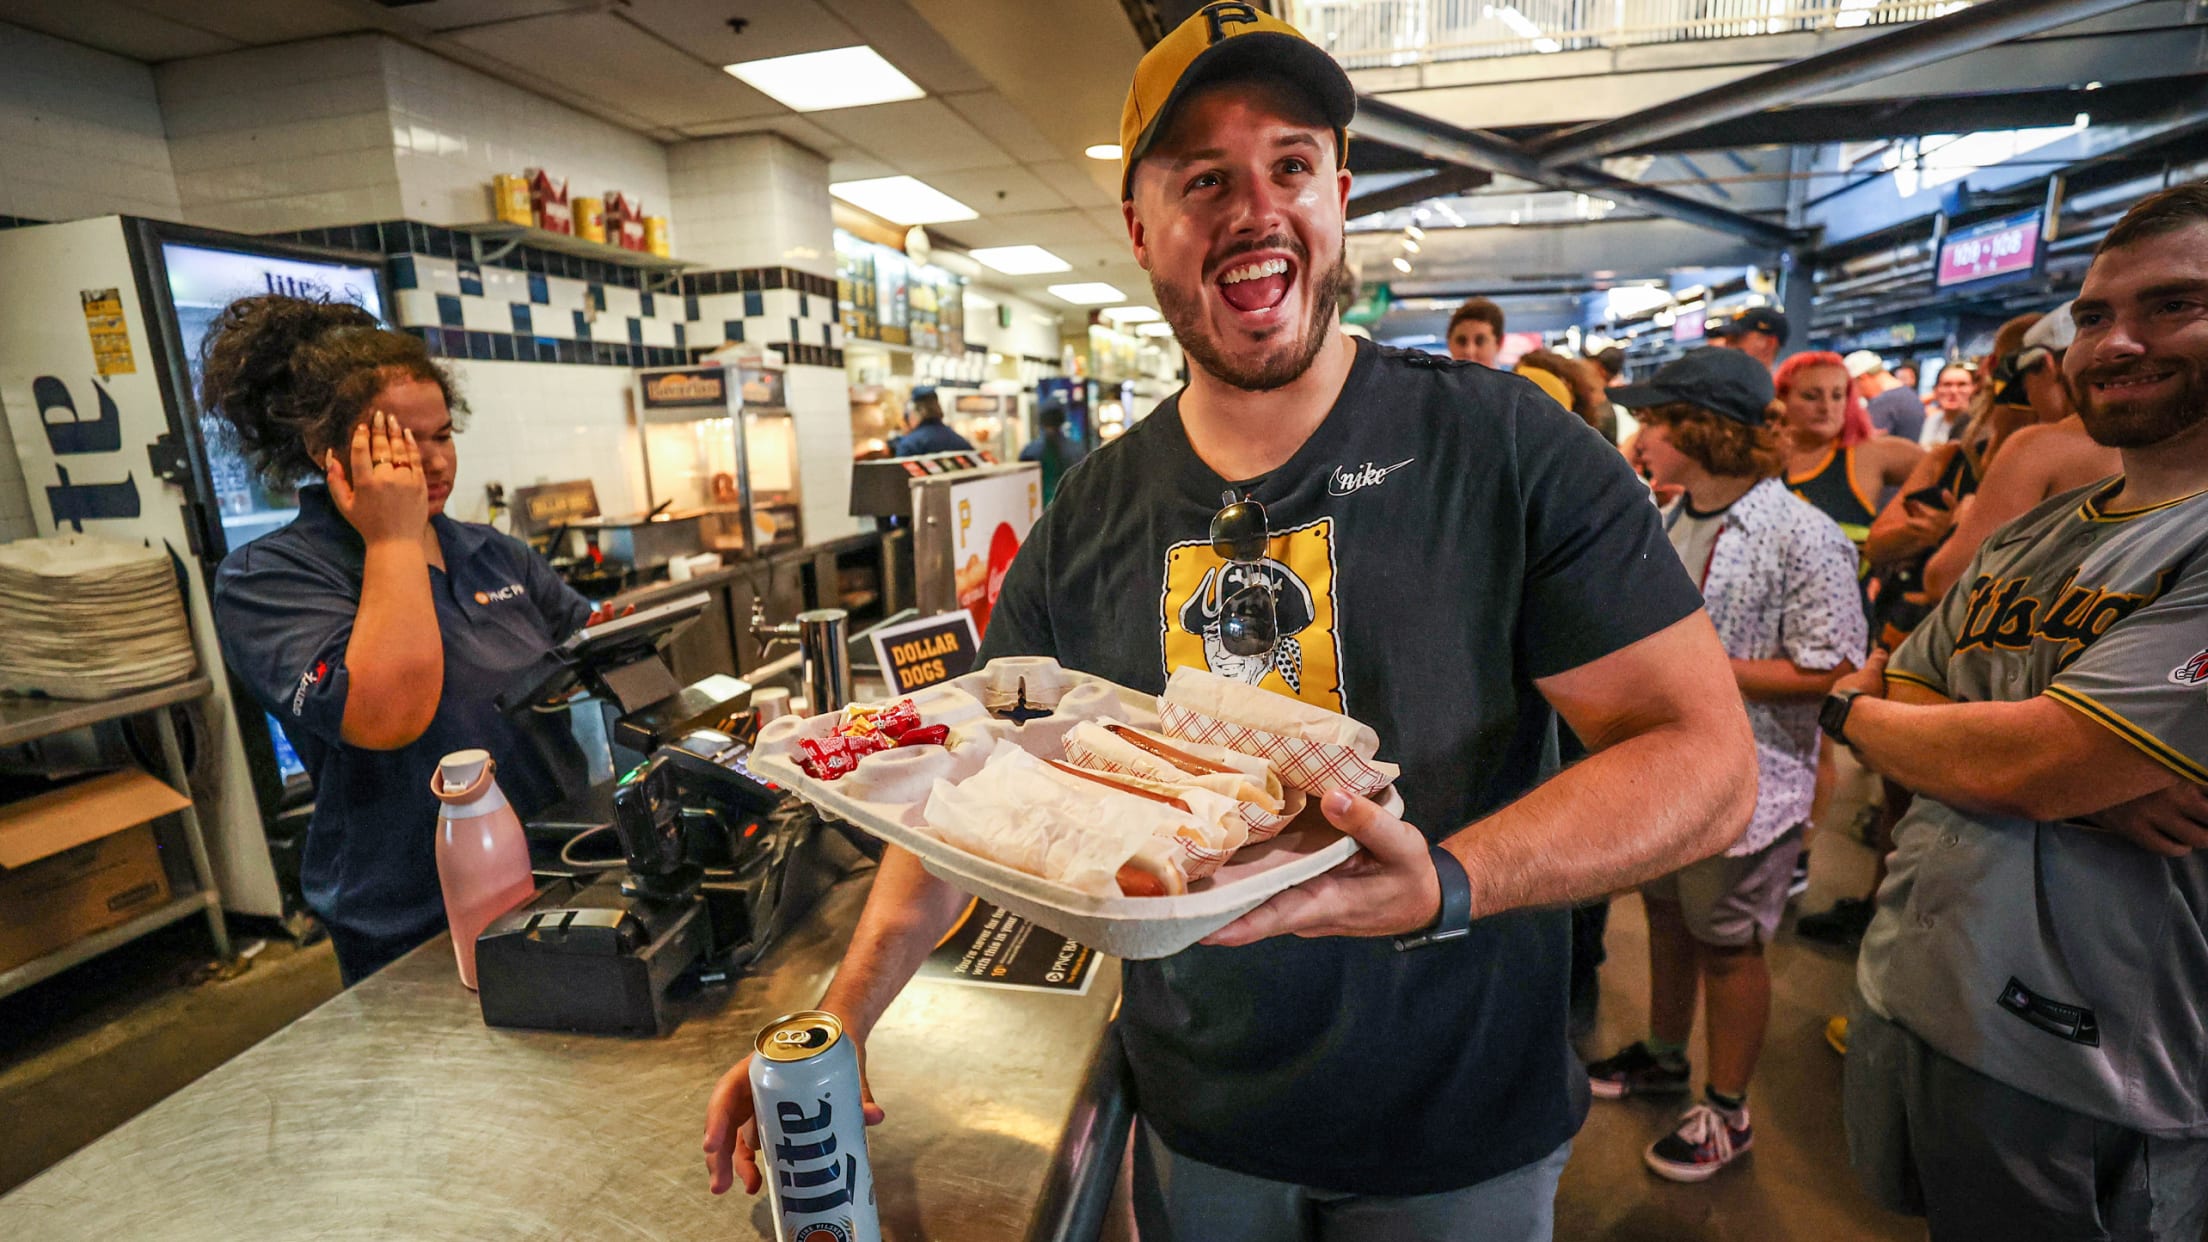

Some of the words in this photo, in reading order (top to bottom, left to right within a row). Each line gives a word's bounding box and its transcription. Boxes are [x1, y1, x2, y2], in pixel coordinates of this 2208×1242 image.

[891, 631, 960, 667] DOLLAR
[898, 658, 948, 689] DOGS
[972, 956, 991, 977] with
[984, 941, 1001, 962] this
[1051, 949, 1072, 973] PNC
[1063, 937, 1079, 956] BA
[775, 1098, 857, 1218] Lite
